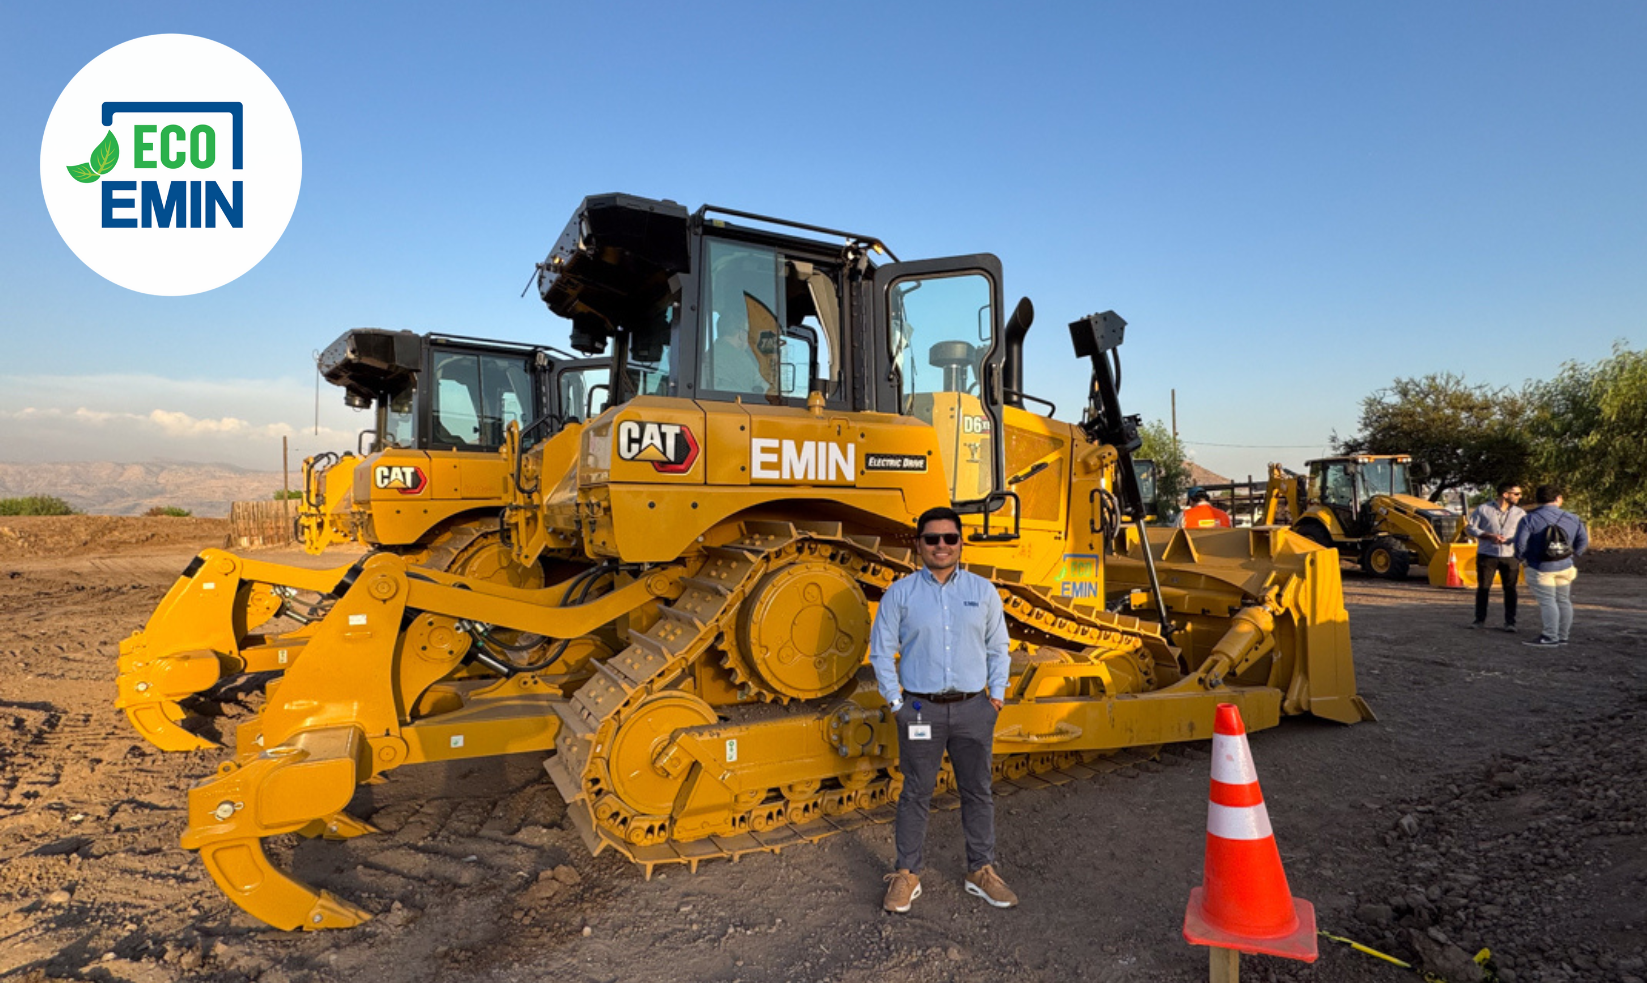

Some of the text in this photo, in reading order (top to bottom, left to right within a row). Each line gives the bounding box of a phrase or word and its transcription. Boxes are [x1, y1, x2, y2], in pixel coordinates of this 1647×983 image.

[619, 421, 681, 462] CAT
[752, 437, 856, 482] EMIN
[375, 466, 415, 489] CAT
[1071, 561, 1092, 577] ECO
[1062, 581, 1098, 598] EMIN
